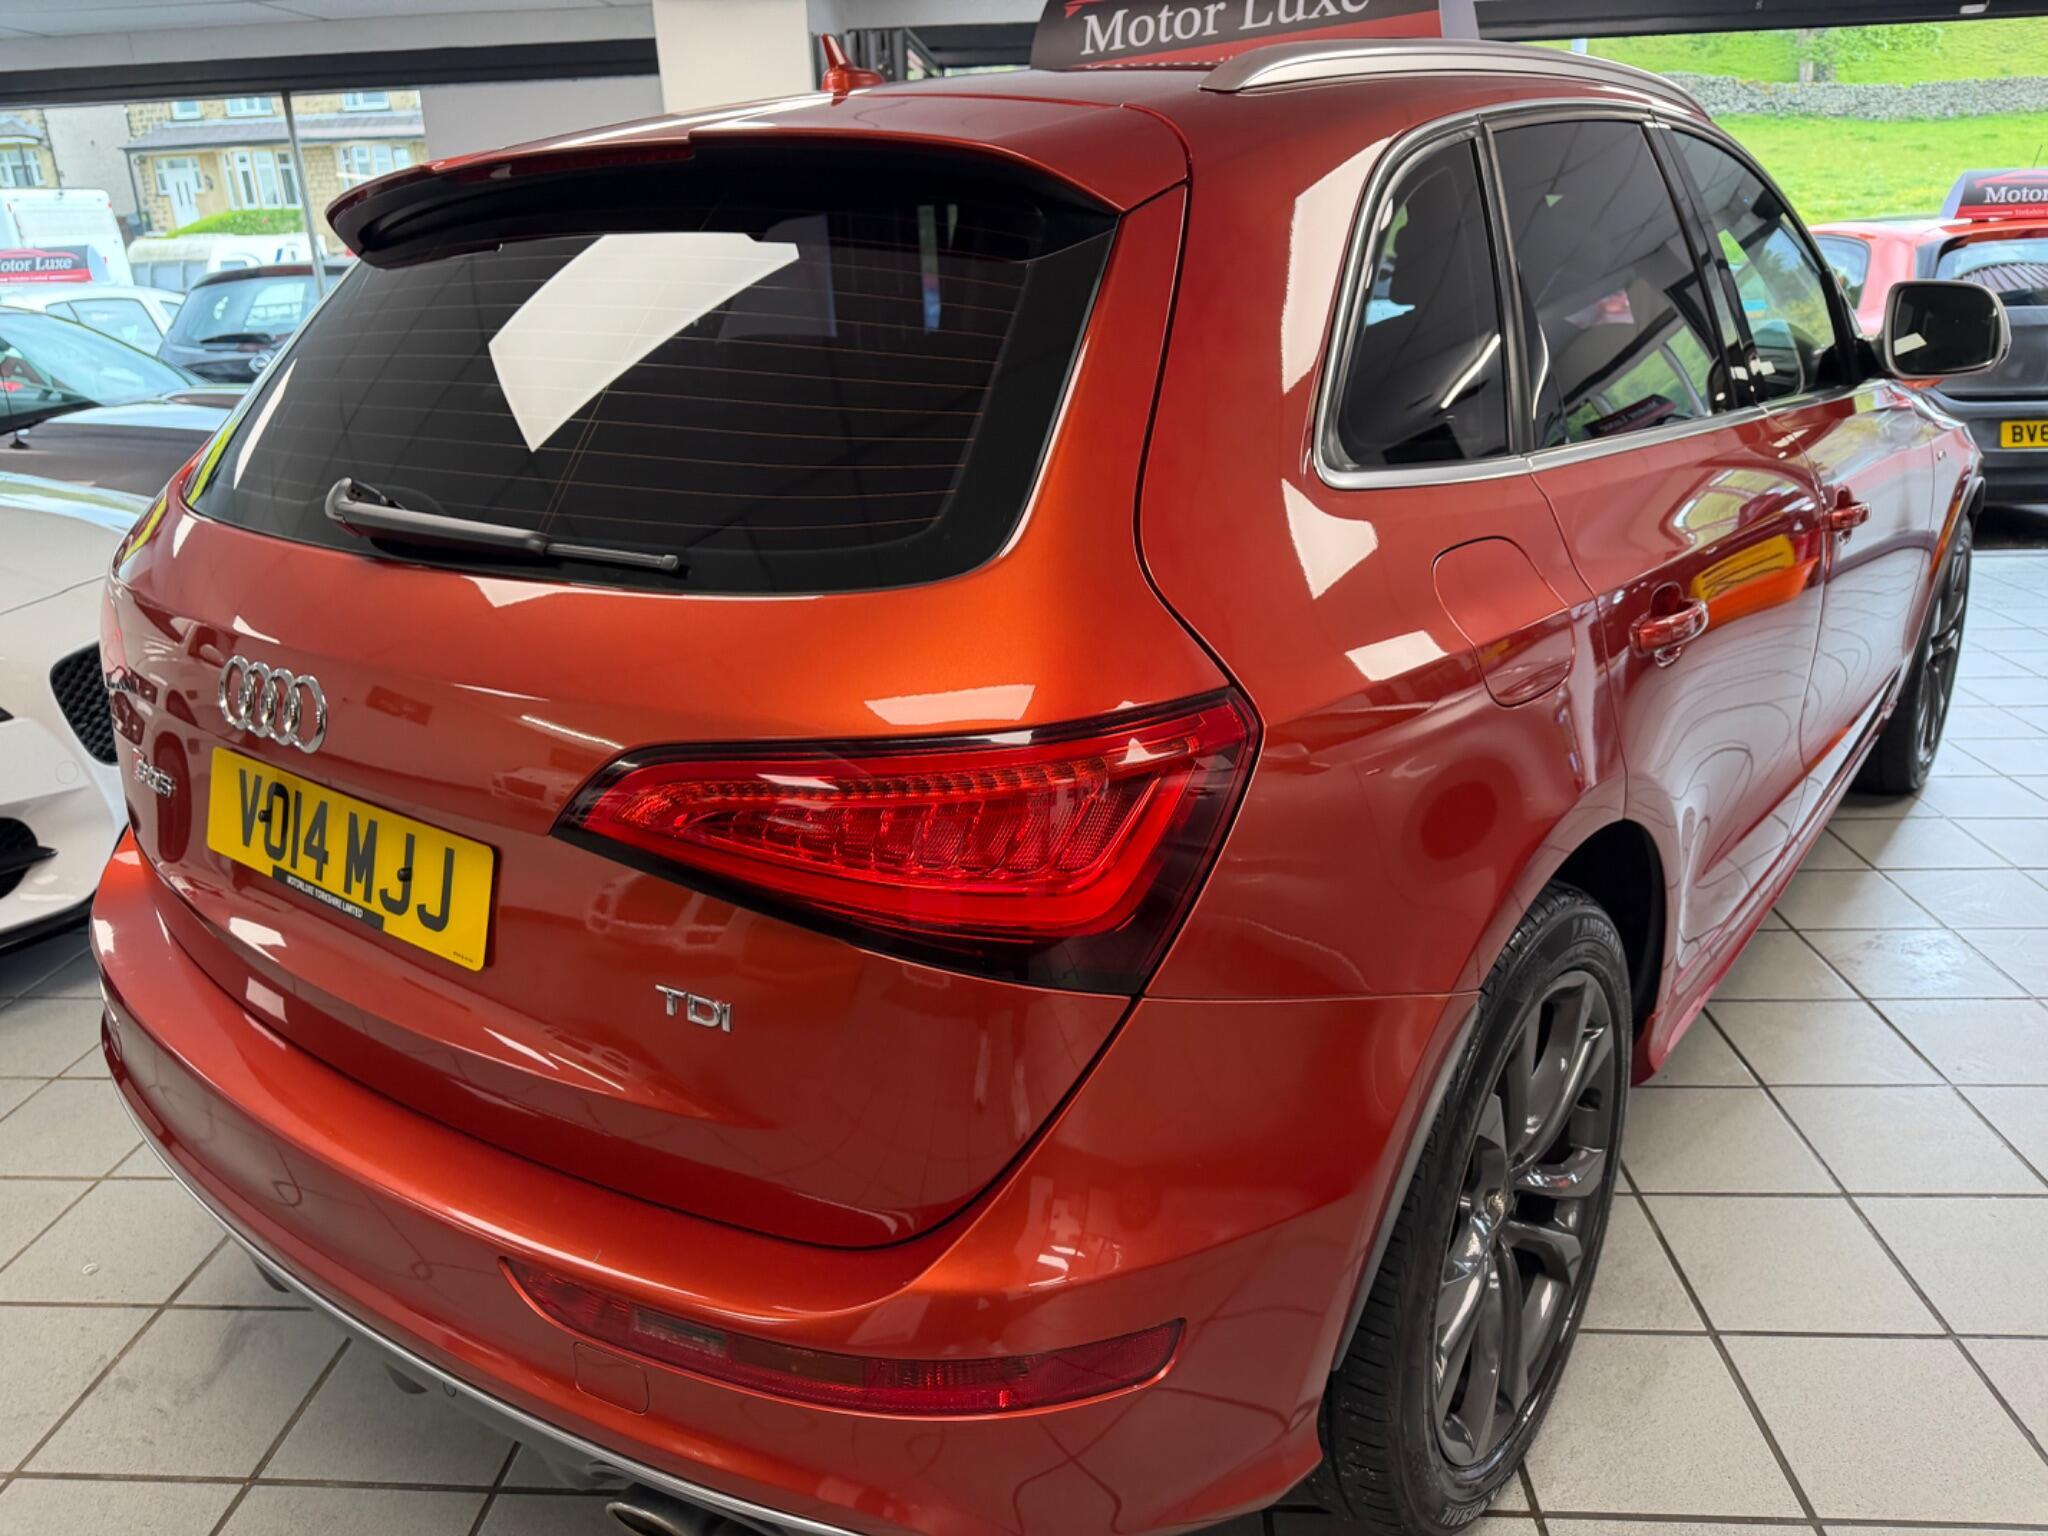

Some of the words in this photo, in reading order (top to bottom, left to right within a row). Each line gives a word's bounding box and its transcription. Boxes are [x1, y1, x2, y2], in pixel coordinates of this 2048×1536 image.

[1080, 2, 1227, 56] Motor
[0, 258, 32, 273] otor
[35, 257, 73, 271] Luxe
[239, 768, 330, 882] VO14
[344, 811, 455, 932] MJJ
[655, 984, 731, 1032] TDI
